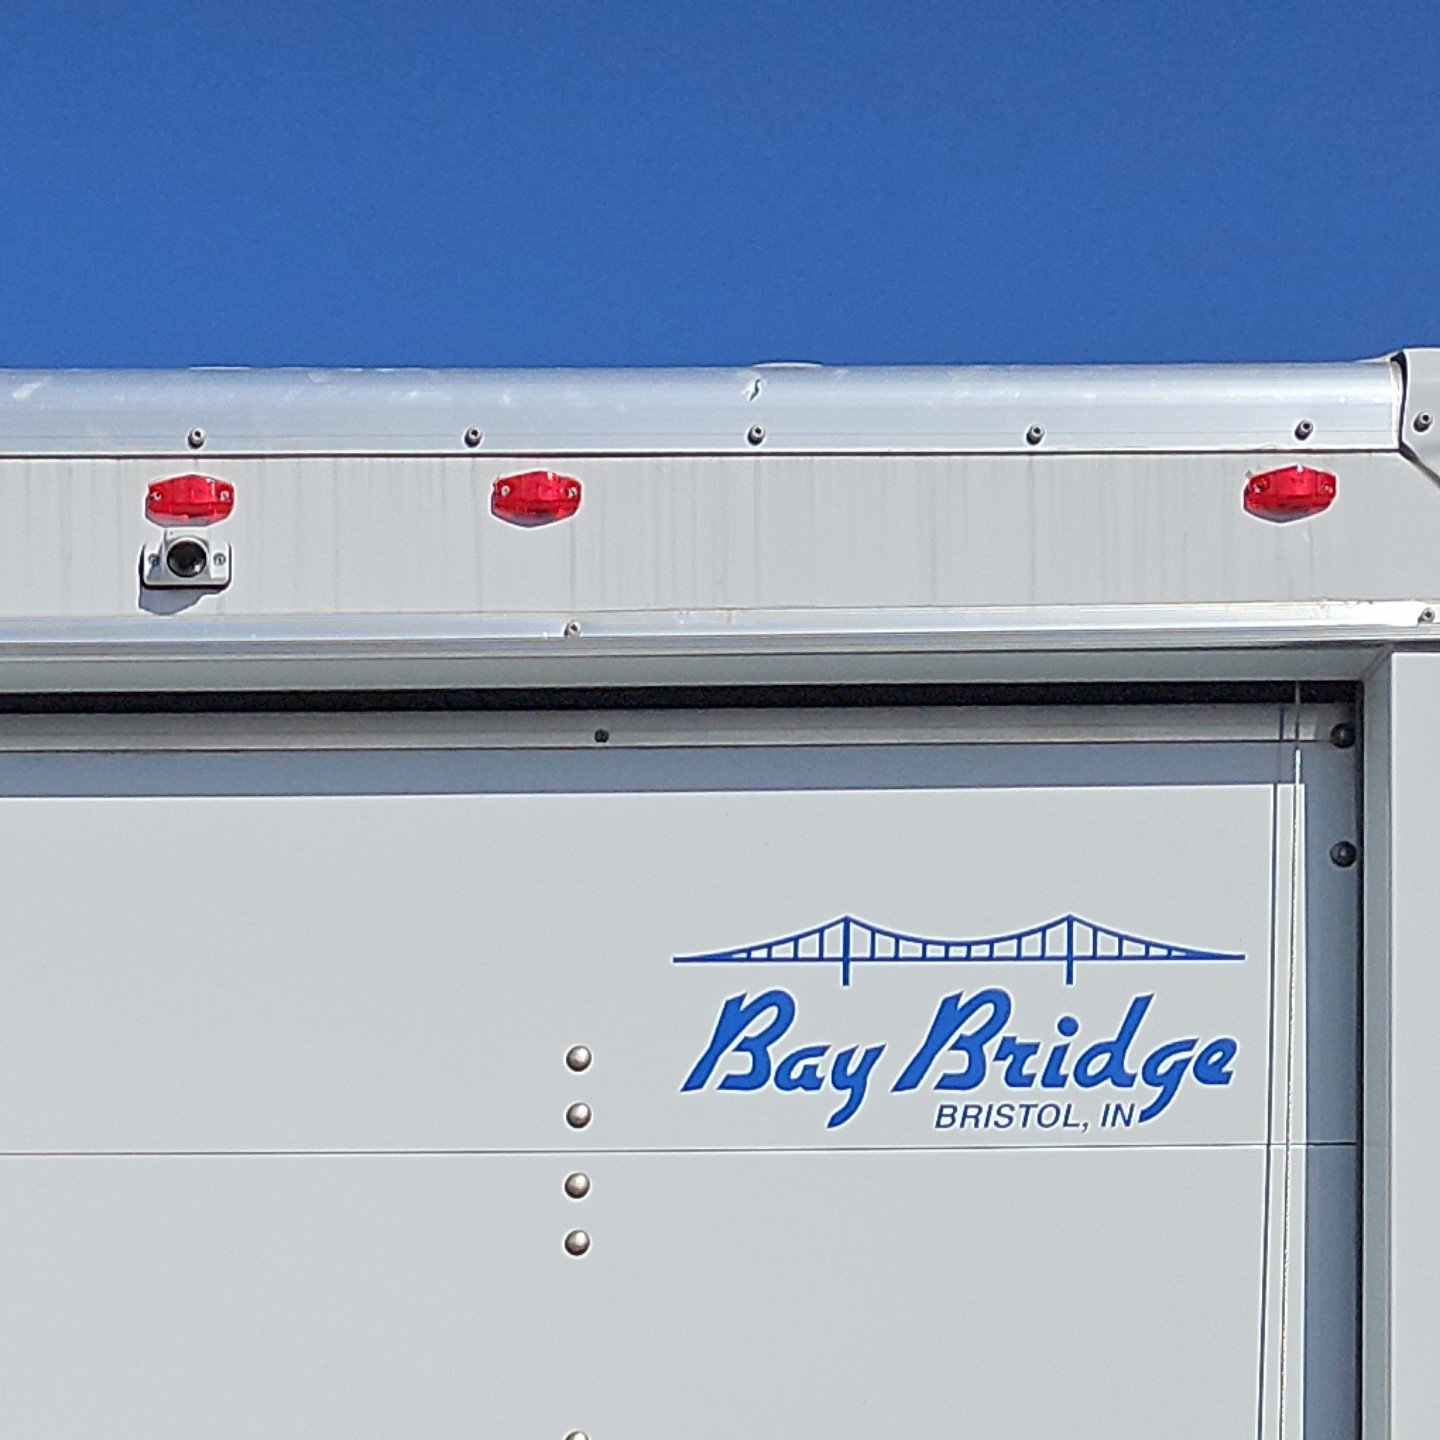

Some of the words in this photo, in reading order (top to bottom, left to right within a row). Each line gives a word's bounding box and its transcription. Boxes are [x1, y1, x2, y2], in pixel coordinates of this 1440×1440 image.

[679, 989, 888, 1129] Bay
[891, 988, 1239, 1123] Bridge
[934, 1103, 1090, 1131] BRISTOL,
[1100, 1103, 1139, 1127] IN
